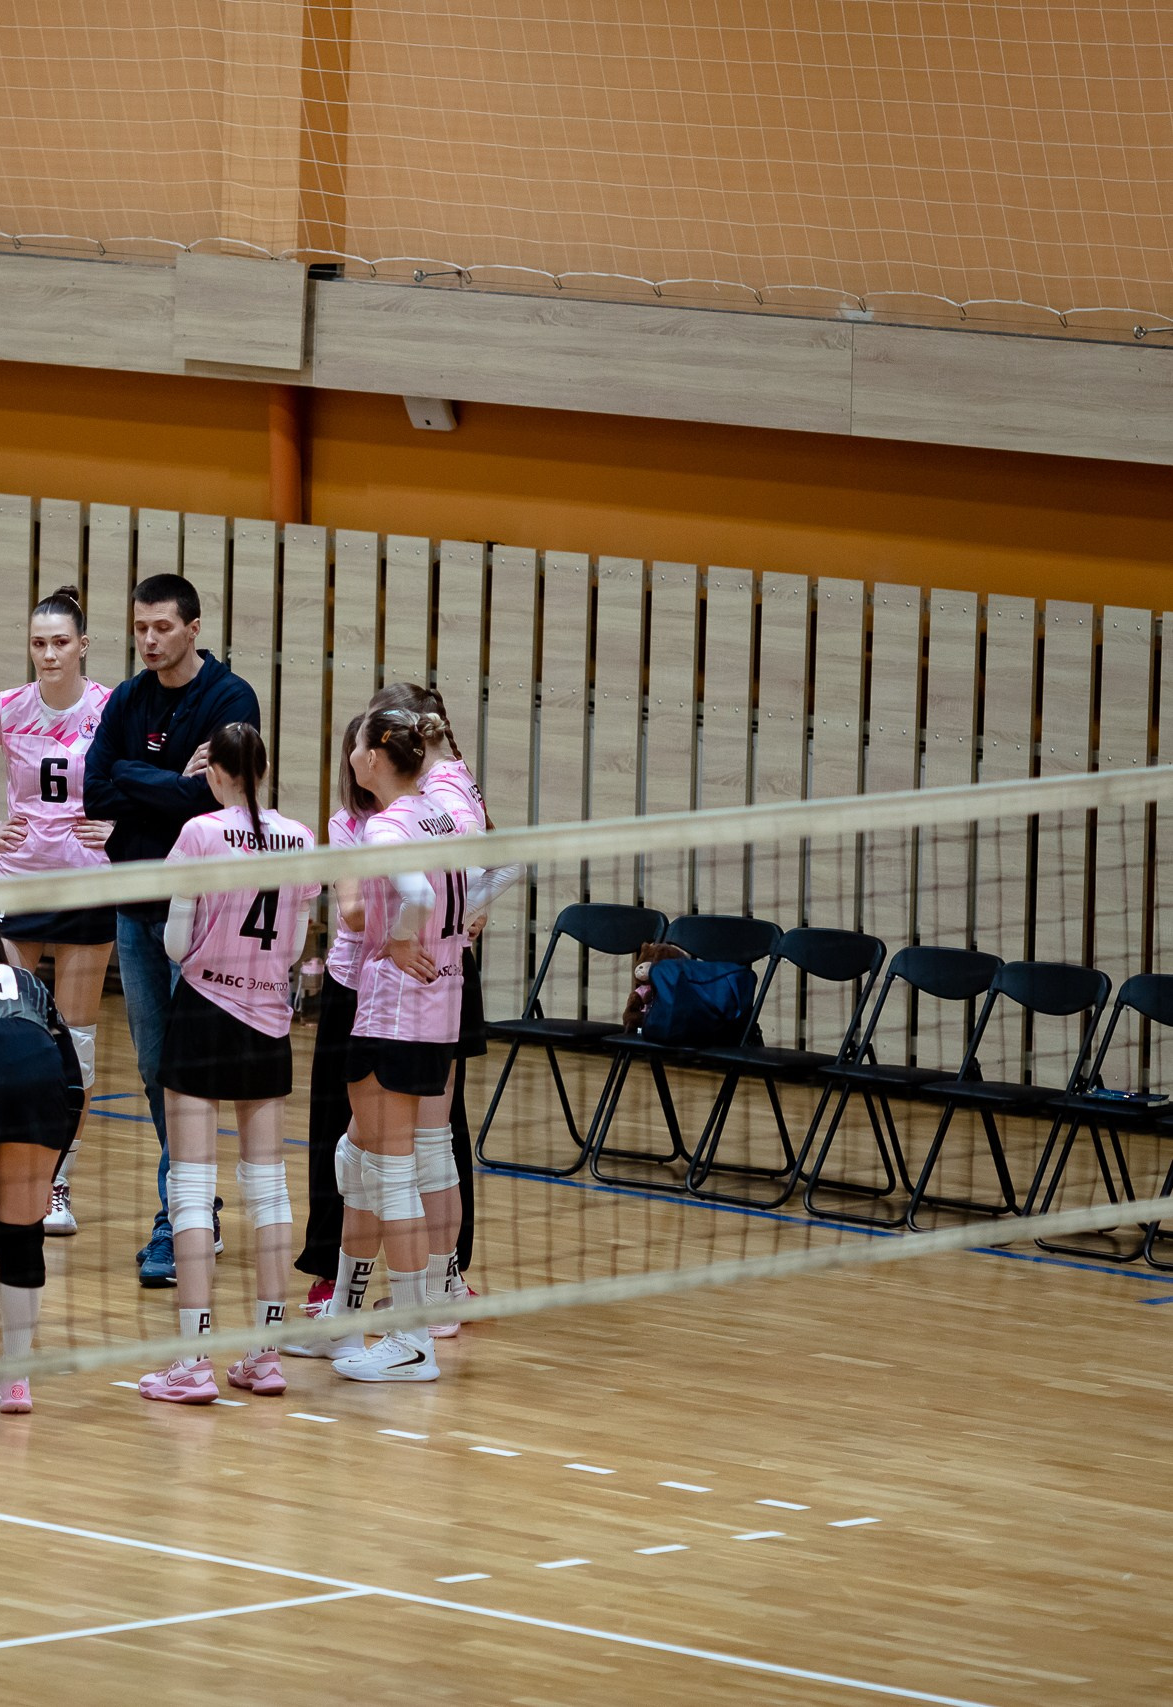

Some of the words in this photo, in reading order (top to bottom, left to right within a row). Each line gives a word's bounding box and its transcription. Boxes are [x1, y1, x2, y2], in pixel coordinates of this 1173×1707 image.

[40, 757, 68, 804] 6
[223, 829, 304, 851] ЧУВАШИЯ
[239, 886, 279, 951] 4
[214, 972, 245, 989] АБС
